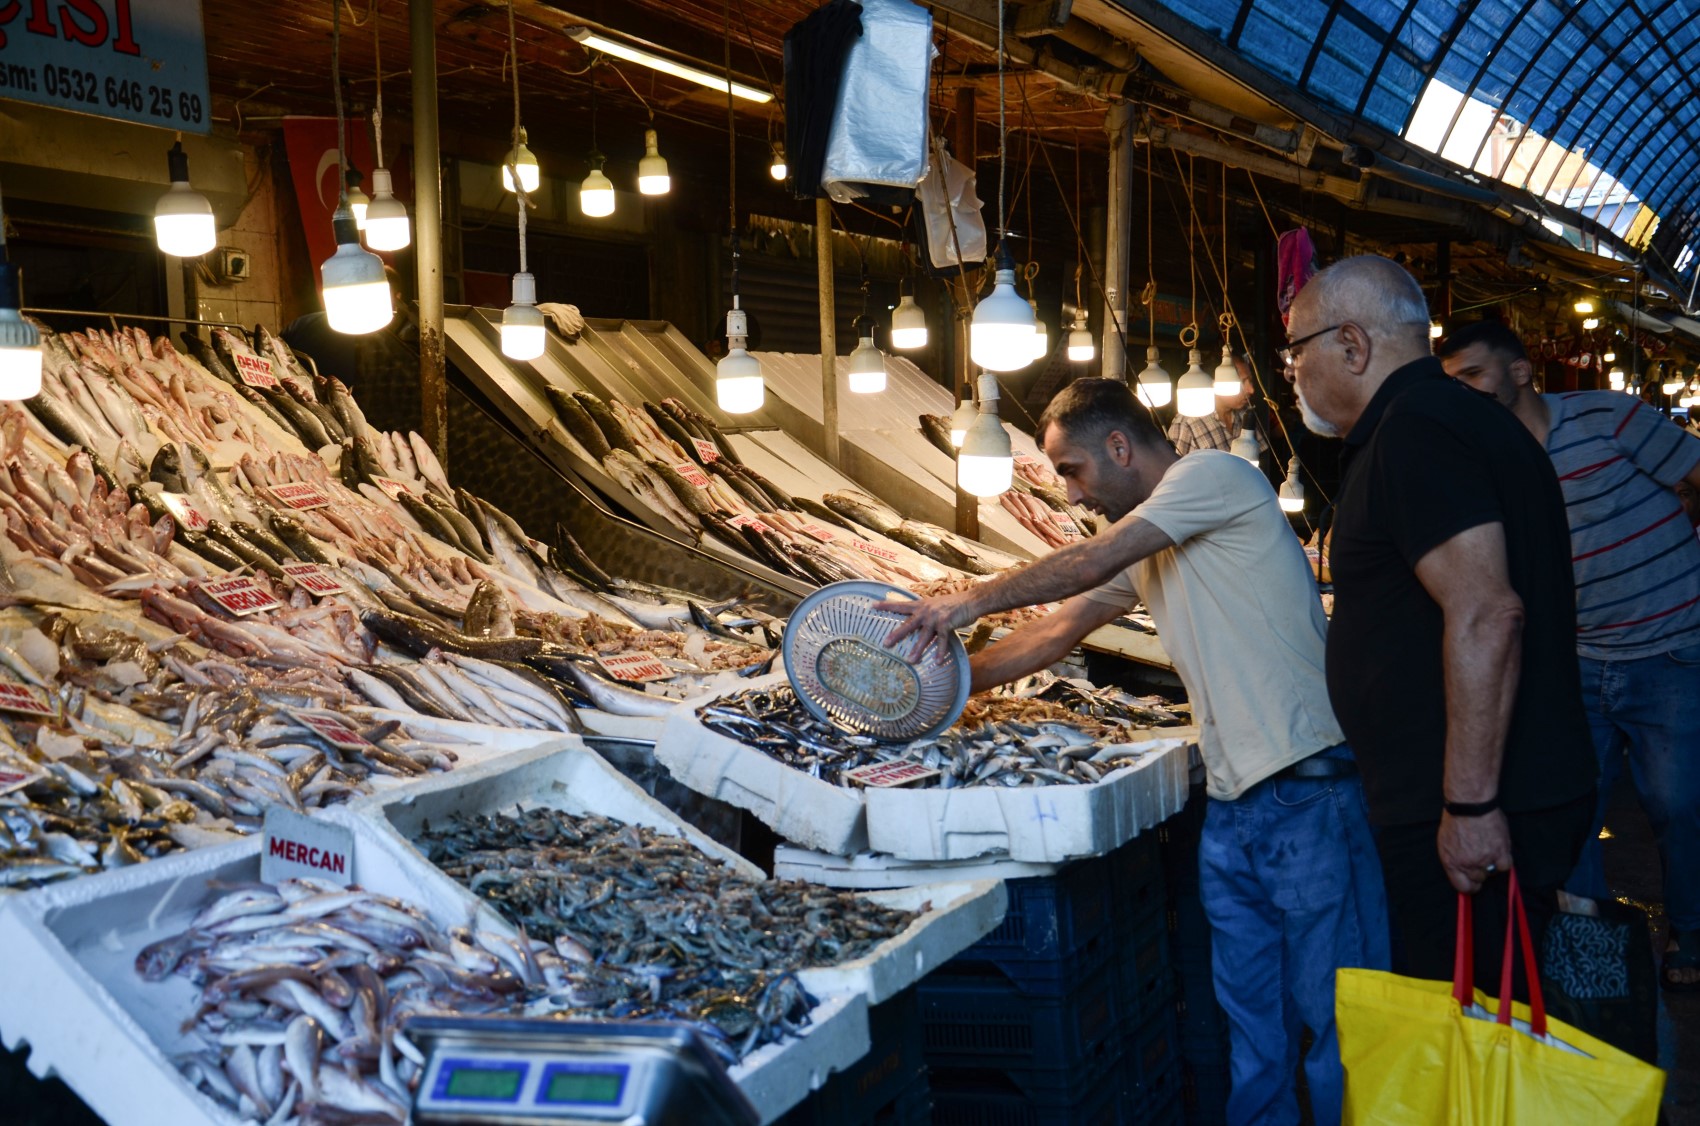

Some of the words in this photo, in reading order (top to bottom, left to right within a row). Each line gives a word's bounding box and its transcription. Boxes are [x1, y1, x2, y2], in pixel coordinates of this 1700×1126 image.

[43, 63, 99, 105] 0532
[105, 76, 143, 113] 646
[149, 85, 173, 119] 25
[178, 91, 201, 124] 69
[216, 588, 278, 611] MERCAN
[612, 663, 670, 680] PALAMUT
[269, 835, 345, 875] MERCAN
